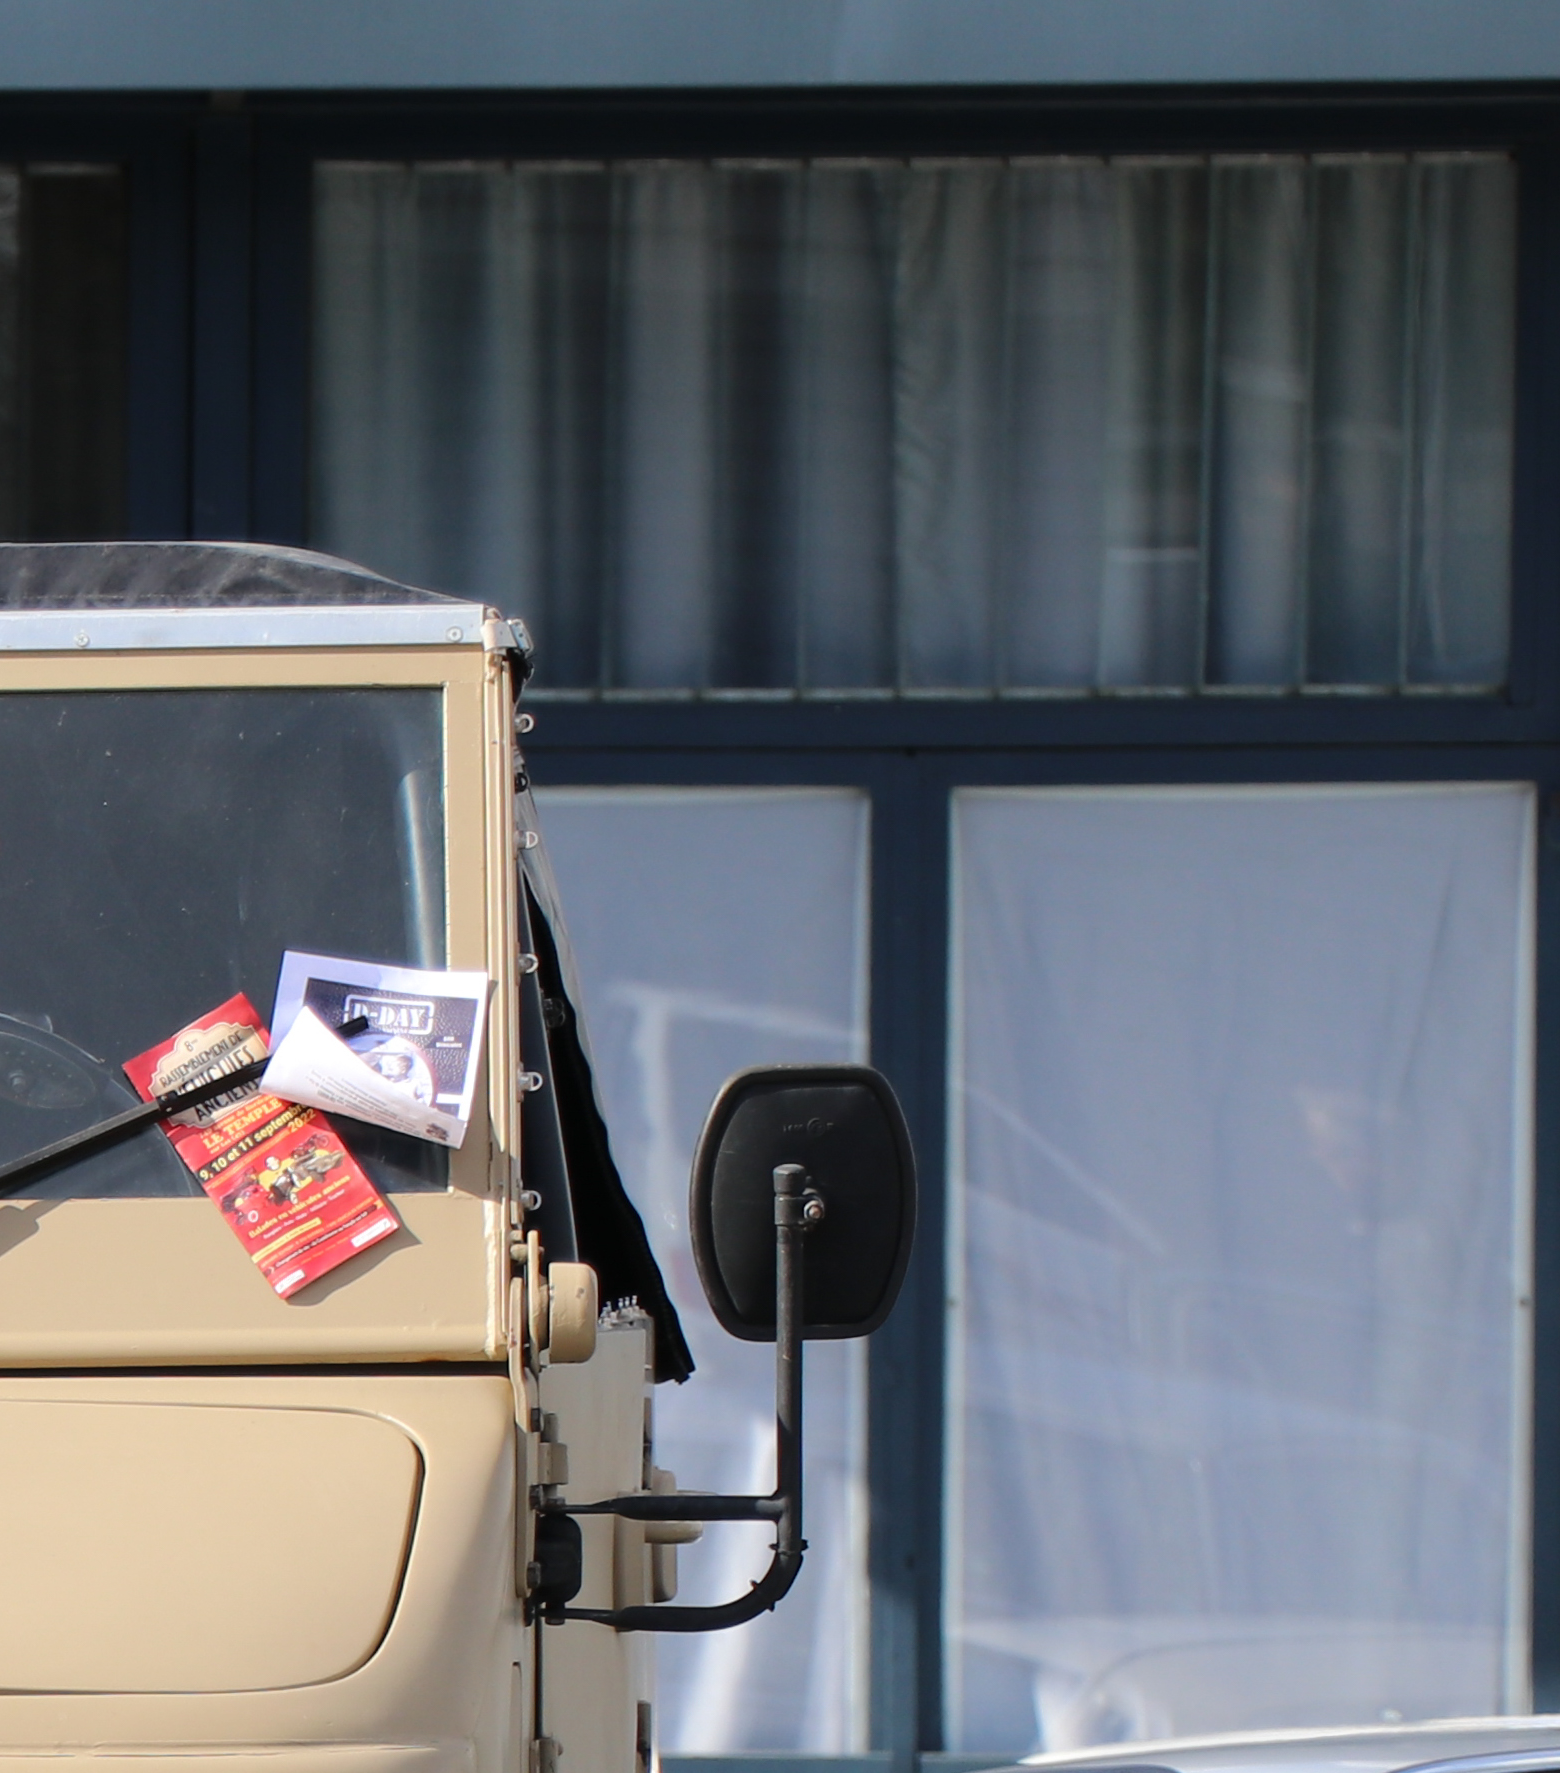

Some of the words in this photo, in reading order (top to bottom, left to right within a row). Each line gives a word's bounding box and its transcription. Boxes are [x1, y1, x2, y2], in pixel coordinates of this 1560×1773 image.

[353, 1003, 425, 1027] D-DAY
[159, 1038, 229, 1088] RASSEMBLEMENT
[228, 1031, 242, 1046] DE
[202, 1132, 224, 1149] LE
[223, 1097, 282, 1136] TEMPLE
[287, 1108, 316, 1133] 2022
[199, 1169, 214, 1181] 9,
[211, 1157, 227, 1172] 10
[227, 1149, 240, 1161] et
[238, 1137, 254, 1151] 11
